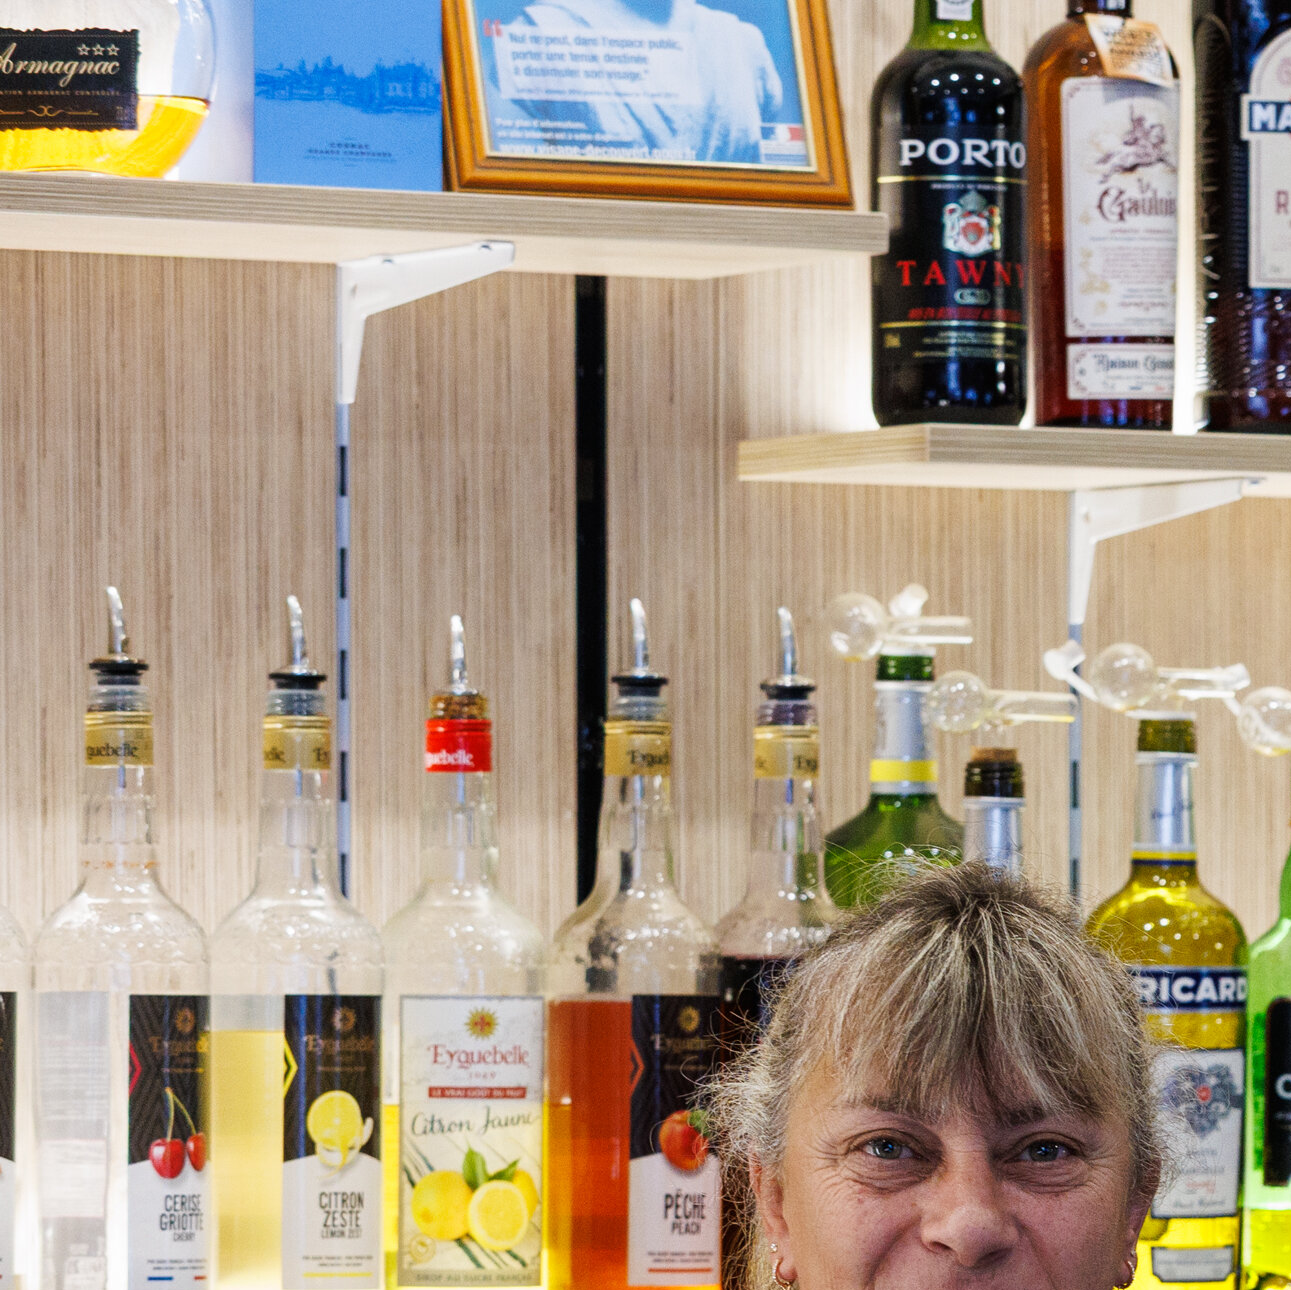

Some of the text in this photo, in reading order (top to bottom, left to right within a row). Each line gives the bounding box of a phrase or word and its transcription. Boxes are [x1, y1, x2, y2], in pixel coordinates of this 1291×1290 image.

[901, 137, 1027, 168] PORTO
[427, 1043, 530, 1069] Eyguebelle
[411, 1105, 541, 1137] Citron Jaune
[165, 1194, 202, 1212] CERISE
[319, 1191, 364, 1209] CITRON
[664, 1188, 706, 1220] PÊCHE
[160, 1213, 204, 1231] GRIOTTE
[323, 1210, 361, 1228] ZESTE
